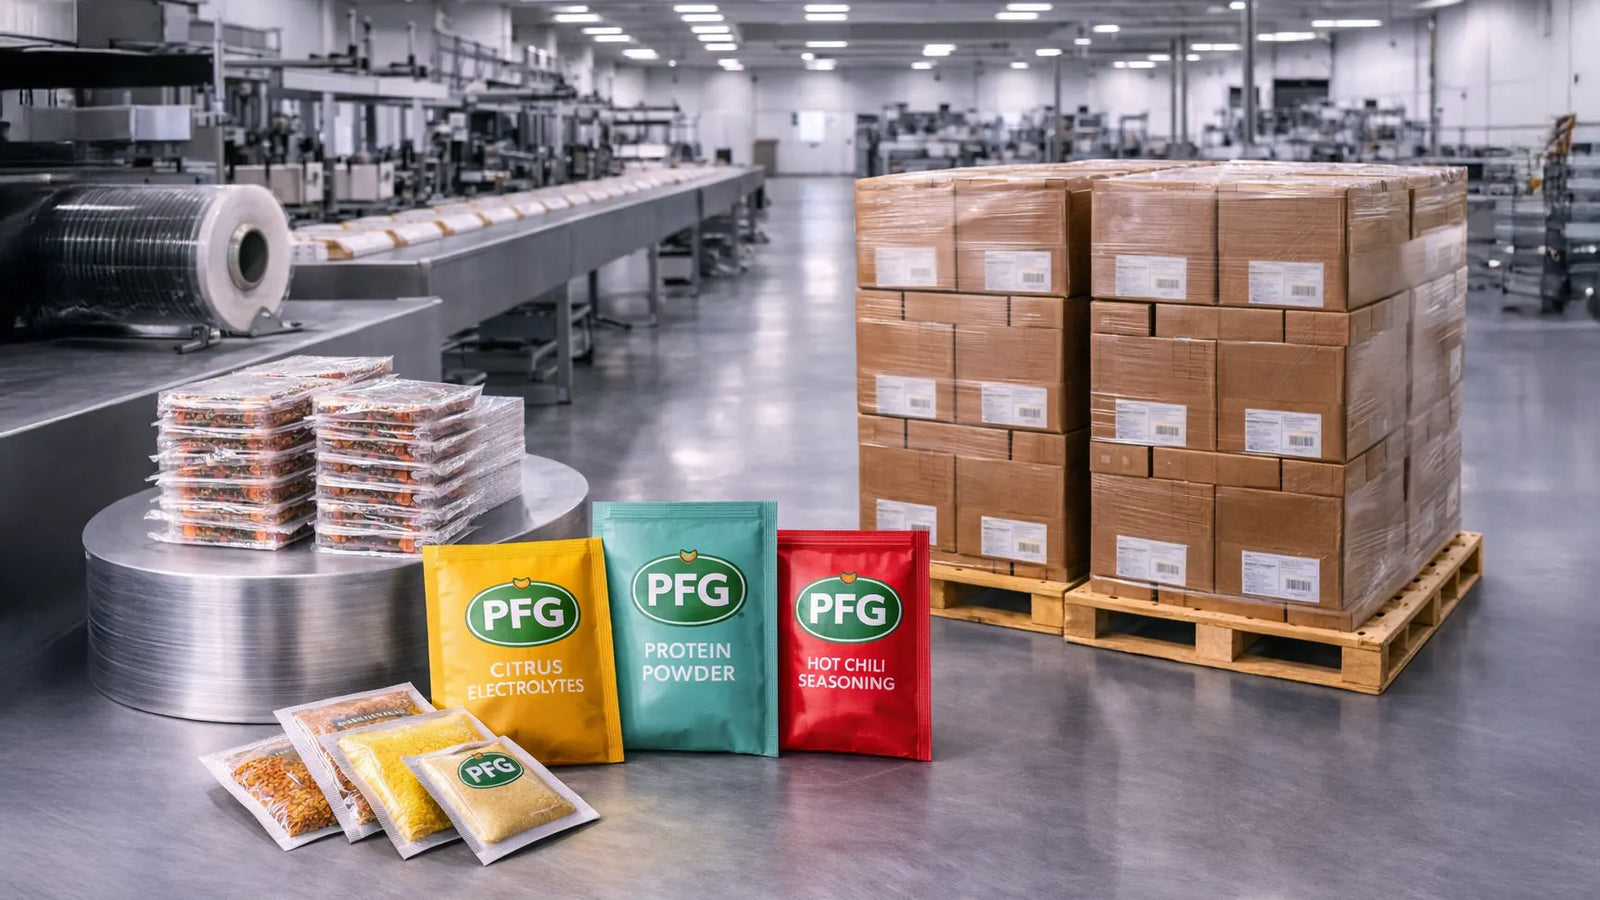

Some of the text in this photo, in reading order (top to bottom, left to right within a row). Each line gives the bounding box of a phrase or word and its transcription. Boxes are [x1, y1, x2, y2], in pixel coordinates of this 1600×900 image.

[648, 572, 729, 606] PFG
[483, 597, 565, 631] PFG
[809, 593, 886, 626] PFG
[645, 642, 731, 659] PROTEIN
[490, 660, 563, 677] CITRUS
[643, 665, 735, 682] POWDER
[807, 657, 886, 672] HOT CHILI
[467, 679, 585, 701] ELECTROLYTES
[798, 673, 895, 690] SEASONING
[464, 757, 517, 784] PFG
